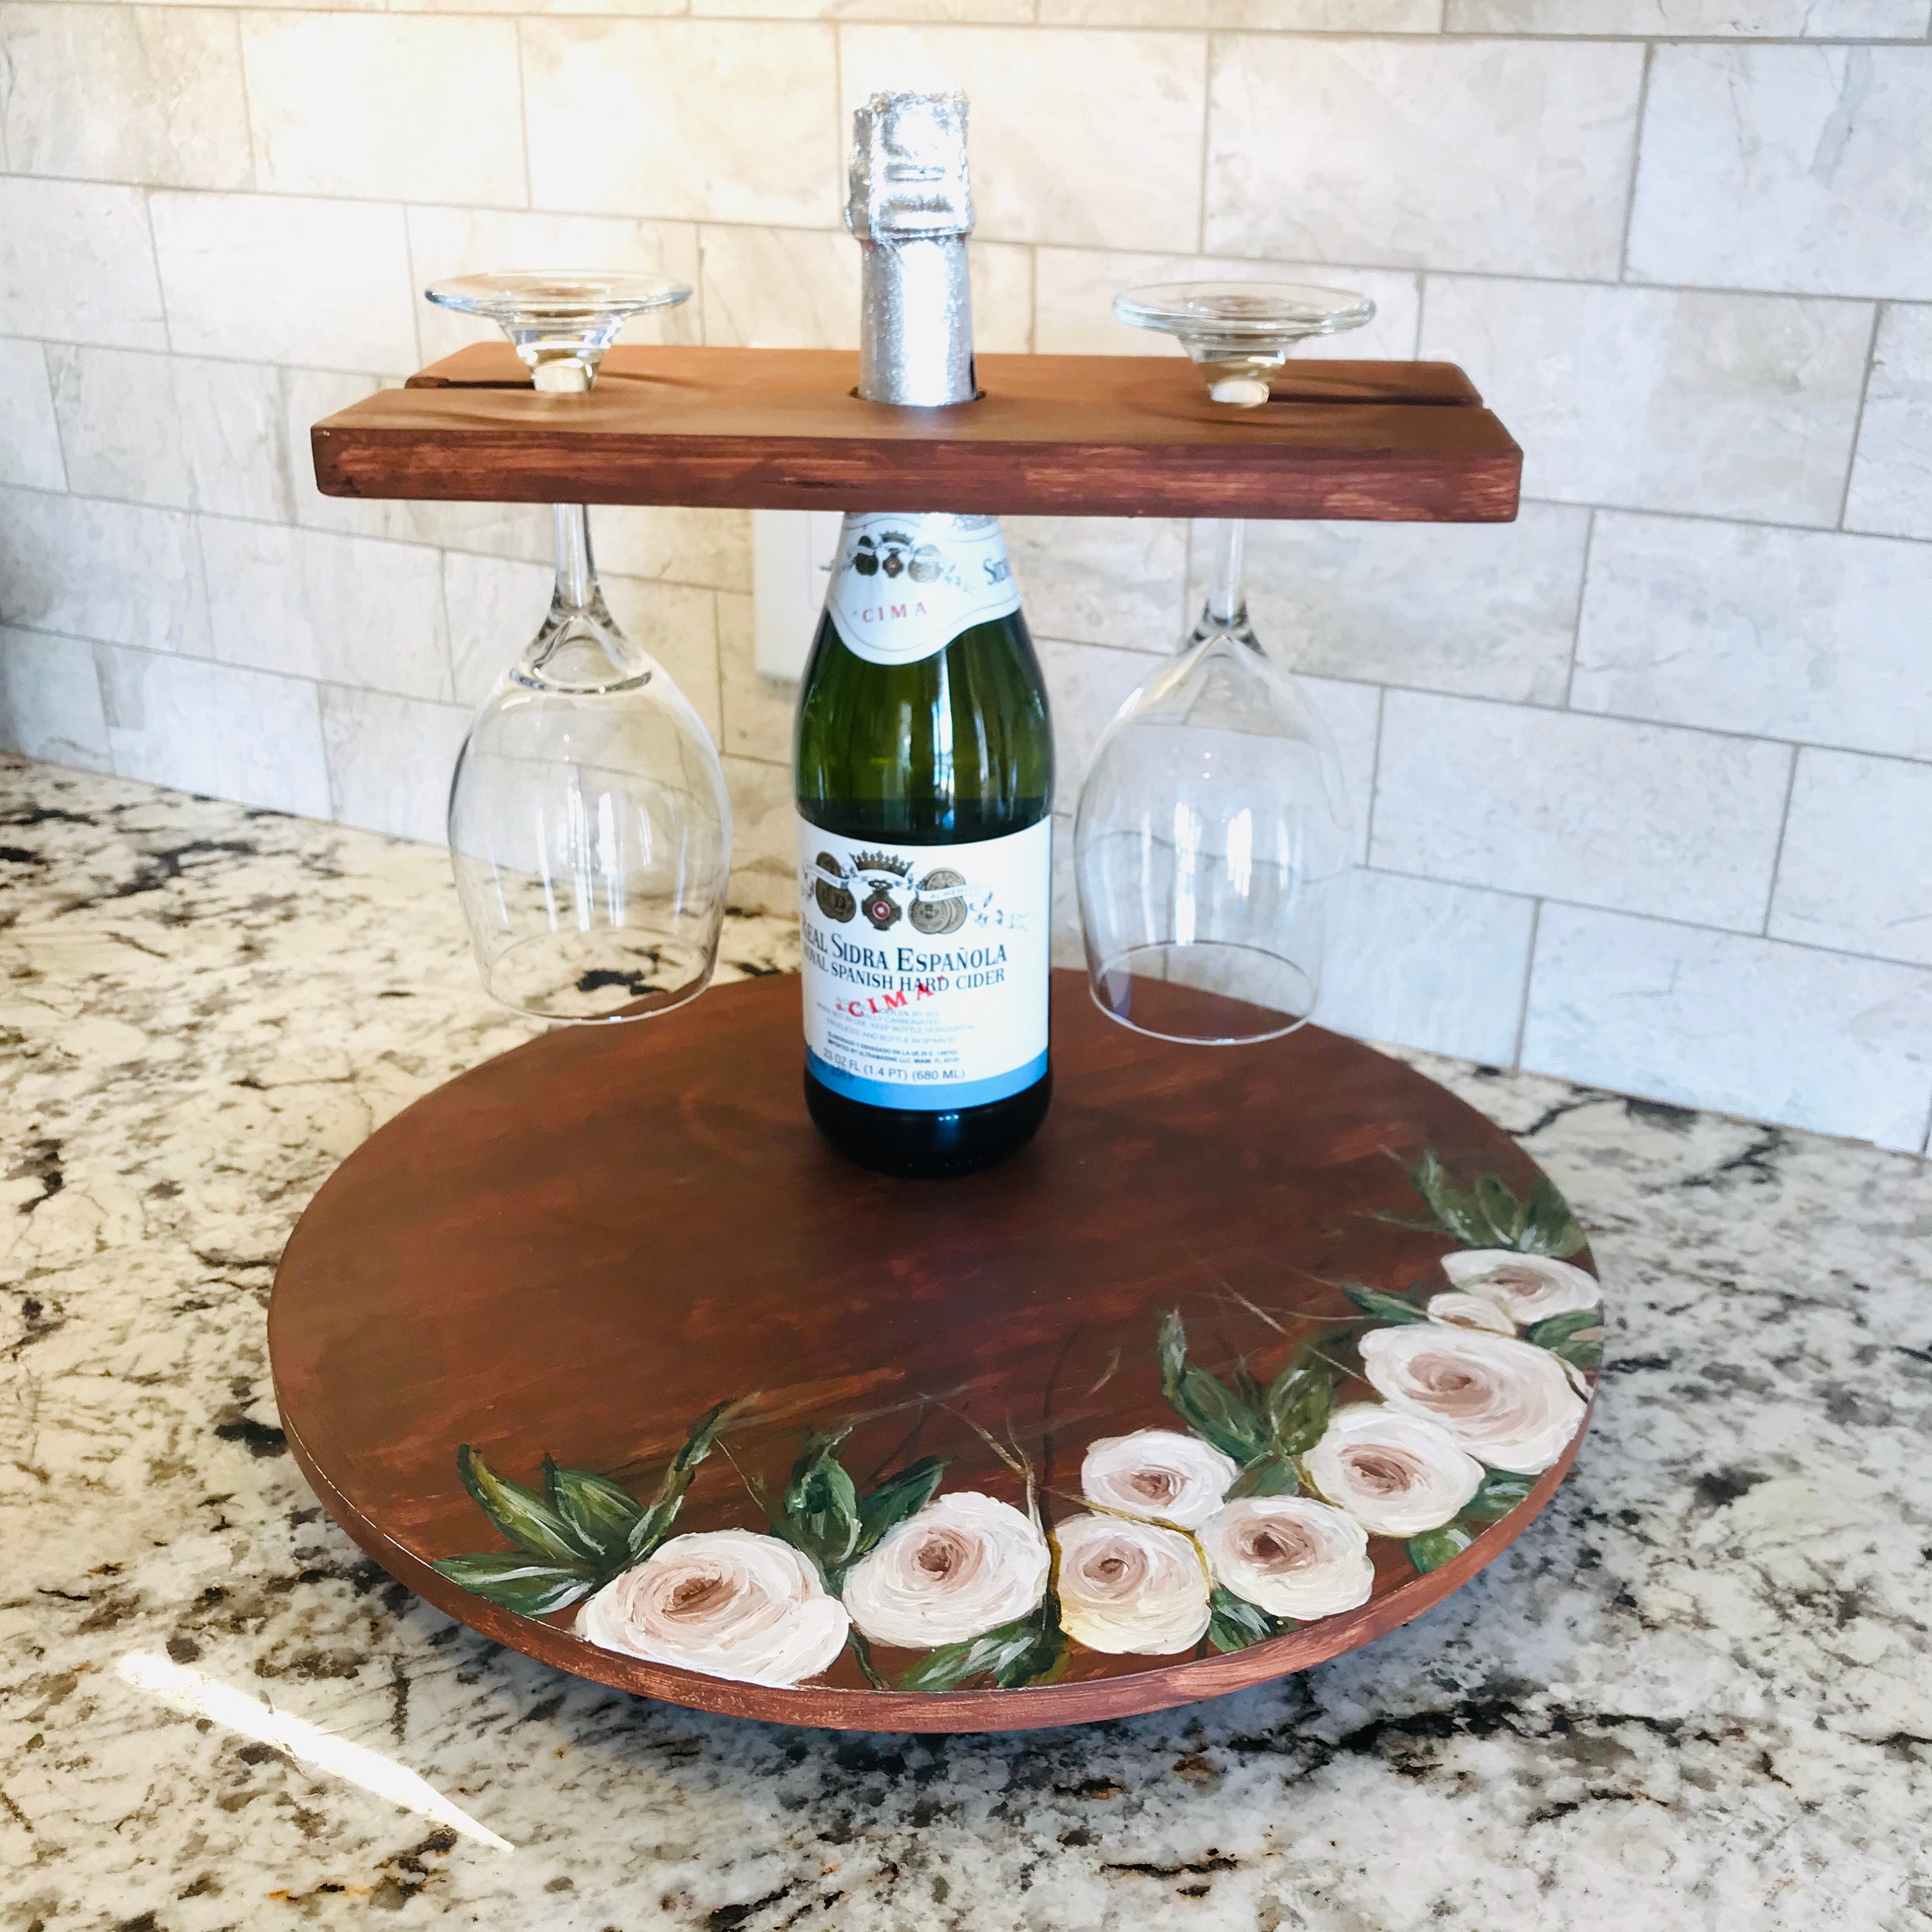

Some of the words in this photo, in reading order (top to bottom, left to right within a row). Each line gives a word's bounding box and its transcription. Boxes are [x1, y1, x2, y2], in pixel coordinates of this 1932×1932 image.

[861, 601, 927, 623] CIMA
[831, 932, 889, 971] SIDRA
[896, 943, 1007, 973] ESPAÑOLA
[831, 961, 894, 990] SPANISH
[900, 976, 950, 992] HARD
[956, 968, 1005, 990] CIDER
[848, 983, 935, 1018] CIMA
[848, 1058, 862, 1072] FL
[888, 1067, 908, 1082] PT)
[912, 1070, 939, 1082] (680
[942, 1068, 965, 1081] ML)
